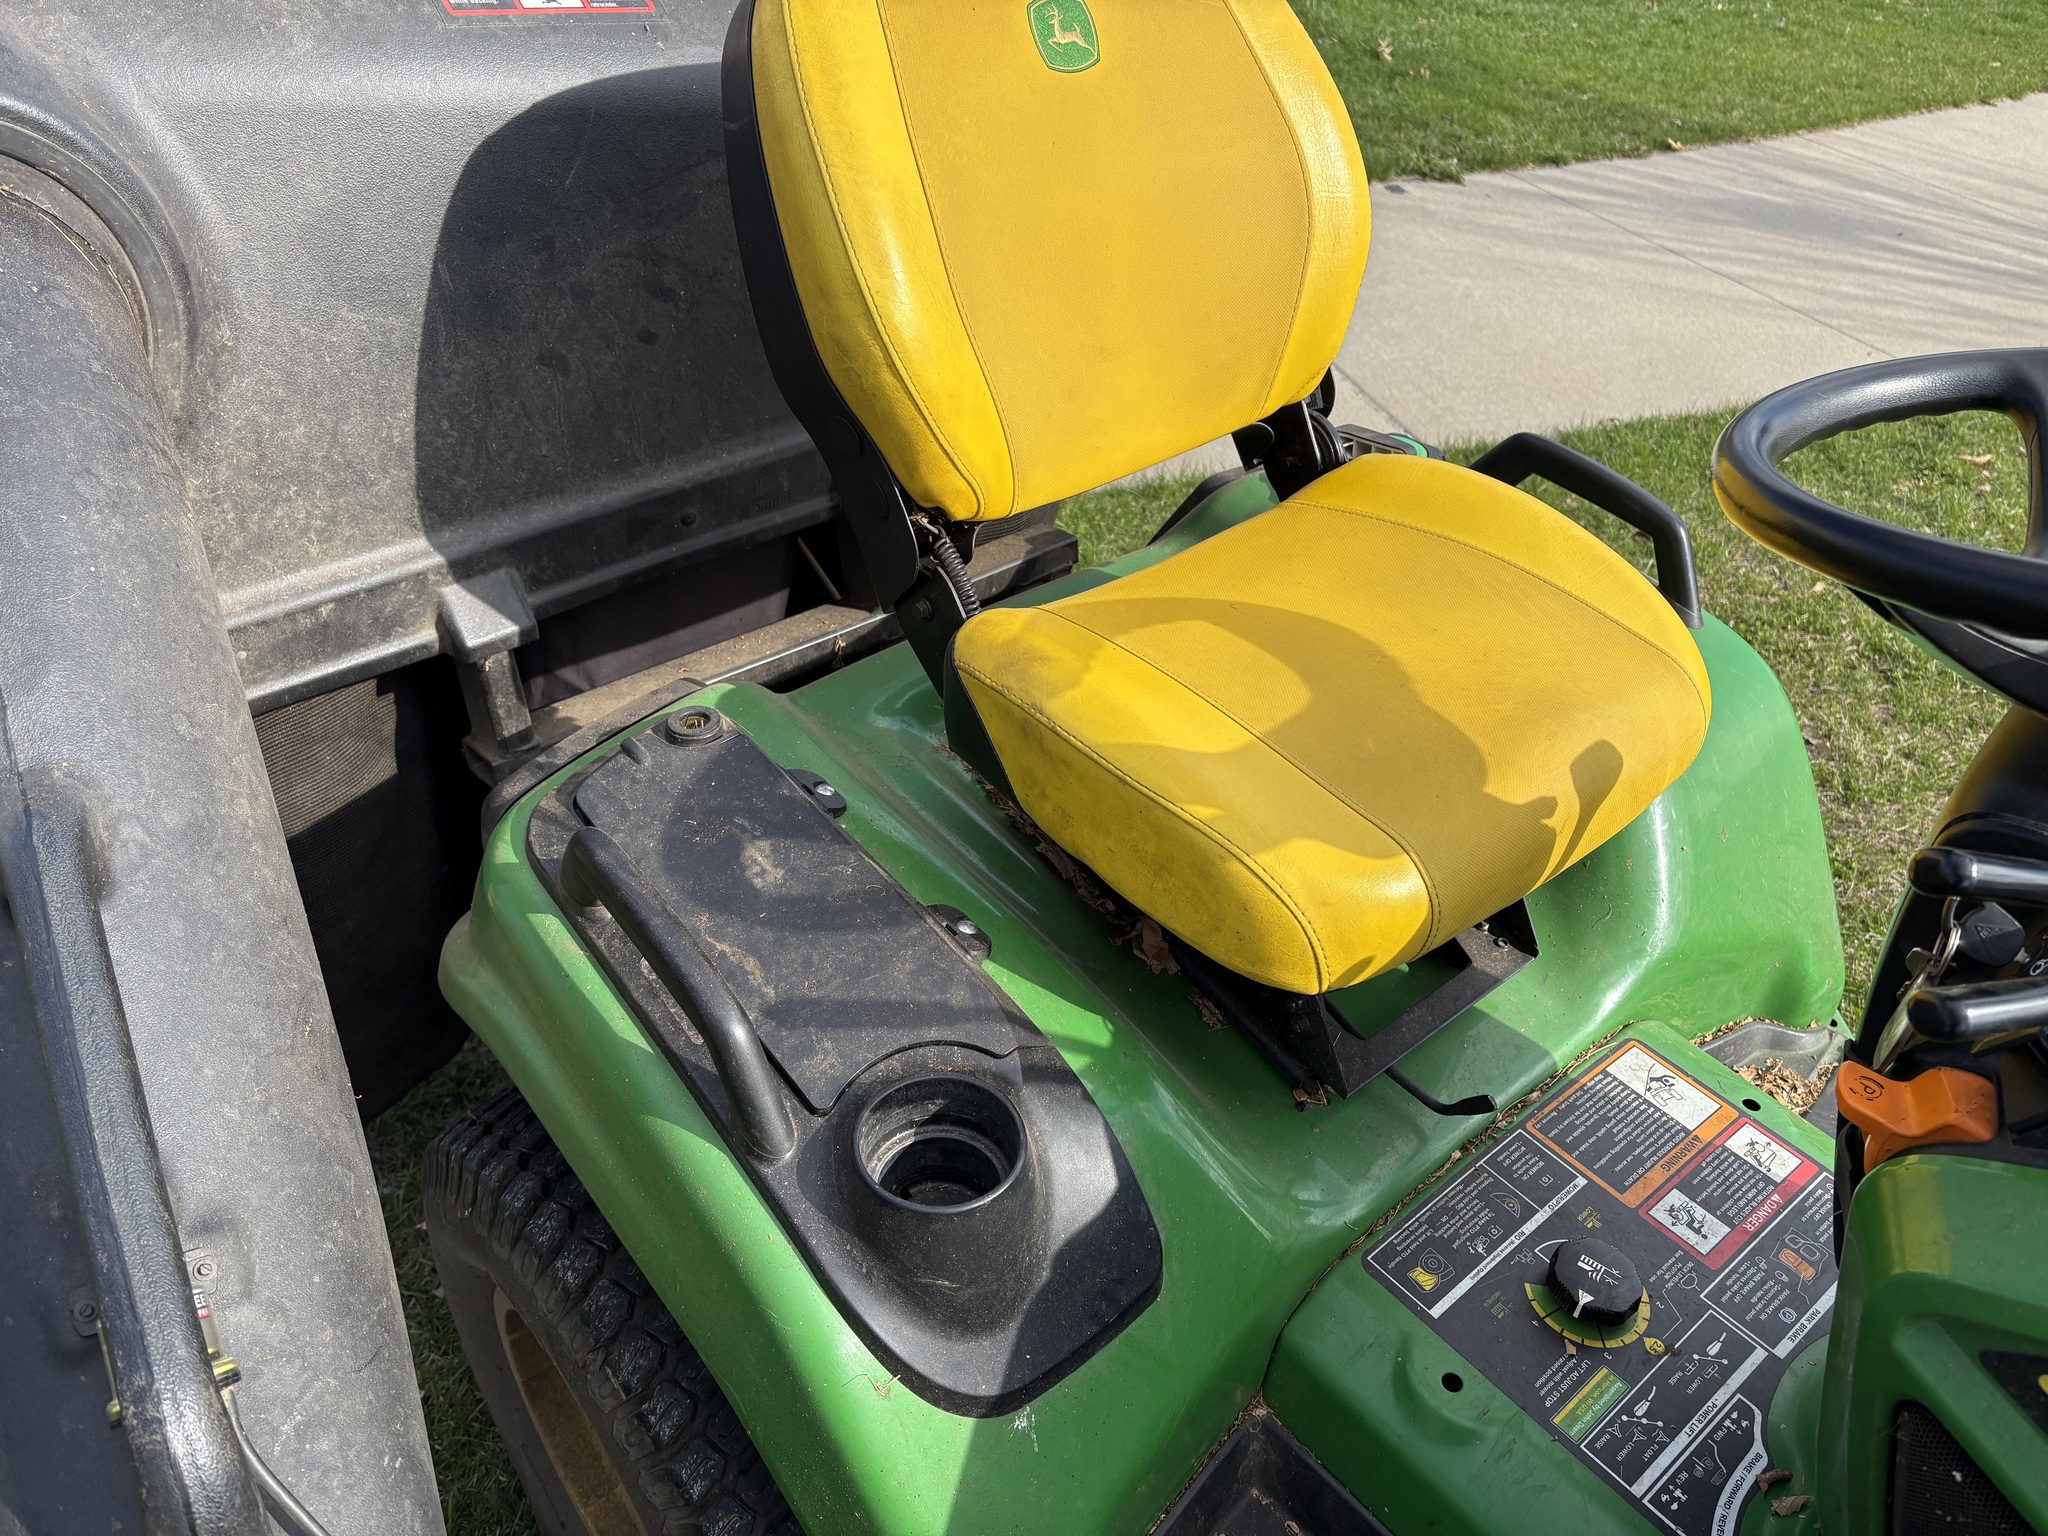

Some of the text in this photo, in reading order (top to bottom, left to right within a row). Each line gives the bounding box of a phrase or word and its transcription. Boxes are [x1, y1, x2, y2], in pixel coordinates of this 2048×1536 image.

[1496, 1141, 1520, 1161] Lower handle
[1501, 1146, 1526, 1167] MOWER OFF
[1659, 1139, 1698, 1172] WARNING
[1520, 1160, 1545, 1181] MOWER ON
[1622, 1172, 1639, 1186] DEATH
[1726, 1180, 1765, 1217] OFF ARMS AND LEGS
[1731, 1184, 1774, 1224] ROTATING BLADES CUT
[1818, 1200, 1833, 1215] CRUISE
[1476, 1215, 1490, 1226] keep
[1487, 1210, 1495, 1218] To
[1576, 1205, 1593, 1221] LOWER
[1742, 1199, 1777, 1231] DANGER
[1811, 1211, 1821, 1221] OFF
[1468, 1224, 1480, 1234] PTO
[1513, 1229, 1526, 1240] RIO
[1399, 1248, 1411, 1258] PTO
[1663, 1261, 1682, 1280] POSITION
[1664, 1260, 1693, 1289] DECK LEVELING
[1725, 1272, 1739, 1286] handle
[1719, 1266, 1756, 1303] Depress brake pedal
[1732, 1270, 1765, 1303] PARK BRAKE OFF
[1482, 1289, 1501, 1307] HIGHER
[1655, 1300, 1664, 1309] 2
[1743, 1284, 1780, 1321] Depress brake pedal
[1749, 1289, 1764, 1304] handle
[1758, 1287, 1790, 1321] PARK BRAKE ON
[1787, 1306, 1819, 1344] PARK BRAKE
[1603, 1351, 1612, 1360] 3
[1648, 1340, 1661, 1352] 2.5
[1550, 1355, 1566, 1371] raised
[1532, 1368, 1553, 1388] position
[1537, 1356, 1577, 1397] Adjust with mower
[1542, 1358, 1591, 1408] LIFT ADJUST STOP
[1667, 1370, 1683, 1385] RAISE
[1685, 1376, 1703, 1394] LOWER
[1568, 1380, 1622, 1437] Assembled by John Deere
[1575, 1403, 1588, 1416] USA
[1683, 1400, 1718, 1437] POWER LIFT
[1594, 1432, 1610, 1449] RAISE
[1712, 1425, 1727, 1441] FWD
[1615, 1441, 1634, 1461] LOWER
[1640, 1442, 1658, 1461] FLOAT
[1743, 1452, 1763, 1474] BRAKE
[1674, 1470, 1688, 1485] REV
[1724, 1475, 1745, 1511] FORWARD
